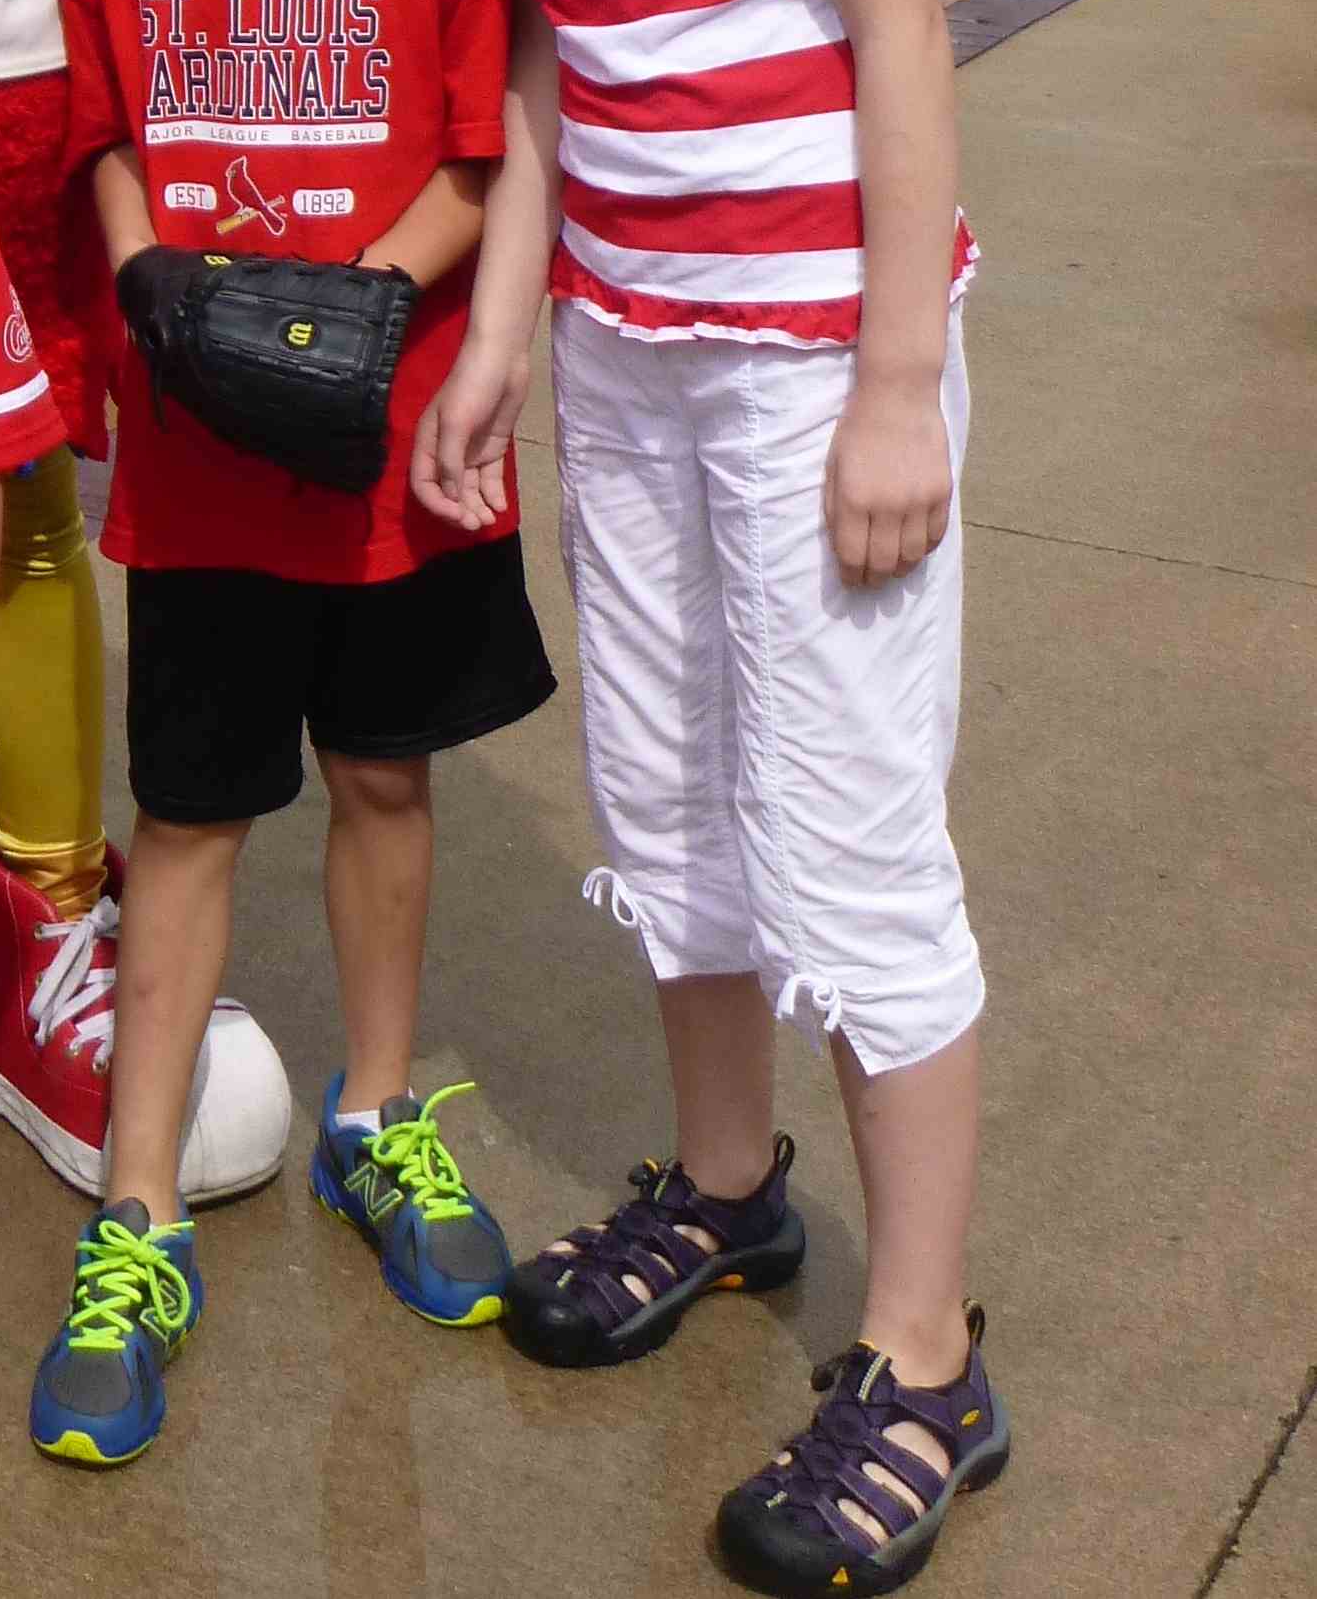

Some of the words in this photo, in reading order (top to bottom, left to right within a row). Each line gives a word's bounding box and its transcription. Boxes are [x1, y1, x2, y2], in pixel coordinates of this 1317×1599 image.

[209, 127, 270, 142] LEAGUE
[291, 128, 378, 142] BASEBALL
[300, 192, 348, 214] 1892
